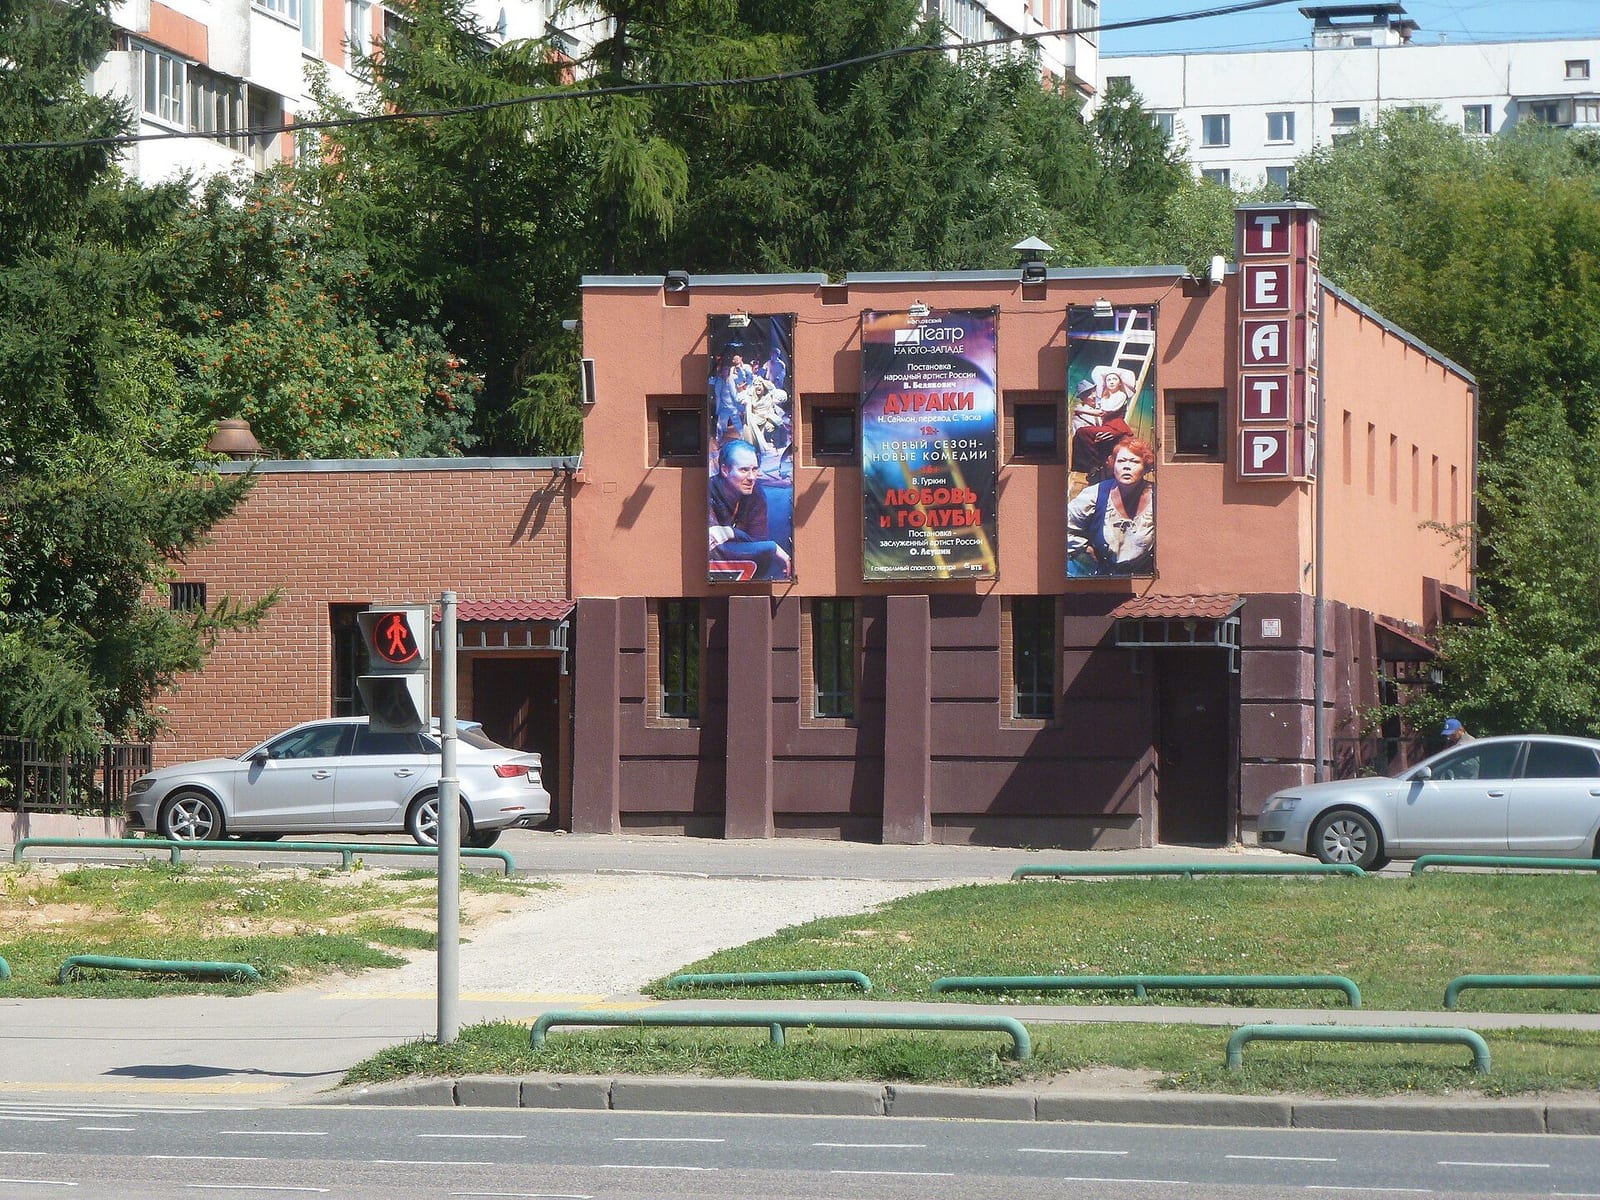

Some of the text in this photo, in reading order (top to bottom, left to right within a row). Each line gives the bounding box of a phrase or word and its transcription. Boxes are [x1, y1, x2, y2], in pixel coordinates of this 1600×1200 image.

[918, 325, 964, 342] Театр
[1251, 215, 1281, 469] ТЕАТР
[884, 373, 921, 382] народный
[948, 371, 976, 379] России
[884, 392, 974, 415] ДУРАКИ
[882, 440, 983, 451] НОВЫЙ СЕЗОН-
[873, 451, 988, 462] НОВЫЕ КОМЕДИИ
[921, 478, 946, 486] Гуркин
[884, 488, 977, 506] ЛЮБОВЬ
[898, 509, 982, 528] ГОЛУБИ
[880, 540, 928, 548] заслуженный
